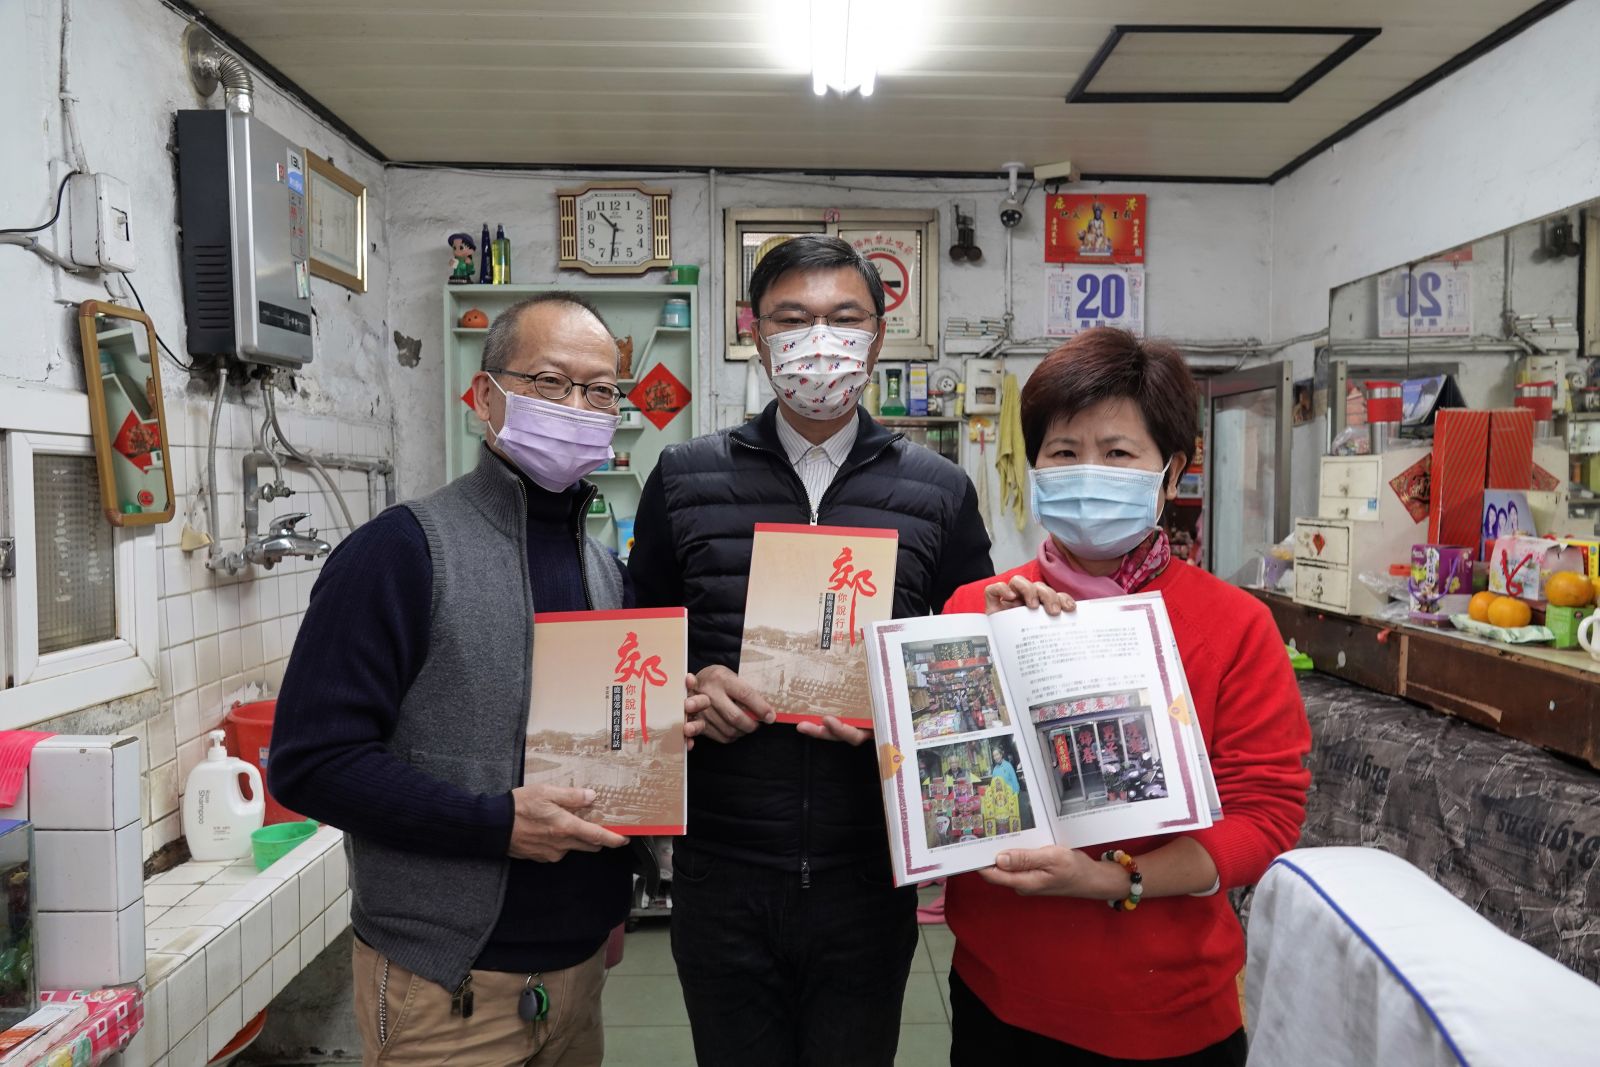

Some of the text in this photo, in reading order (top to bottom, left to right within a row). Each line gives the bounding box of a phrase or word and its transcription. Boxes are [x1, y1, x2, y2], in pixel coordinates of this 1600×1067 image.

[597, 201, 605, 211] 11
[609, 200, 621, 211] 12
[626, 201, 630, 211] 1
[586, 210, 596, 220] 10
[636, 210, 643, 220] 2
[587, 224, 595, 234] 9
[636, 224, 643, 234] 3
[588, 239, 595, 249] 8
[637, 239, 643, 248] 4
[599, 248, 606, 258] 7
[626, 248, 633, 258] 5
[871, 247, 897, 255] SMOKING
[1076, 273, 1125, 319] 20
[828, 546, 877, 648] 郊
[833, 592, 848, 642] 你說行話
[614, 631, 668, 745] 郊
[624, 684, 637, 740] 你說行話
[198, 790, 206, 825] Shampoo
